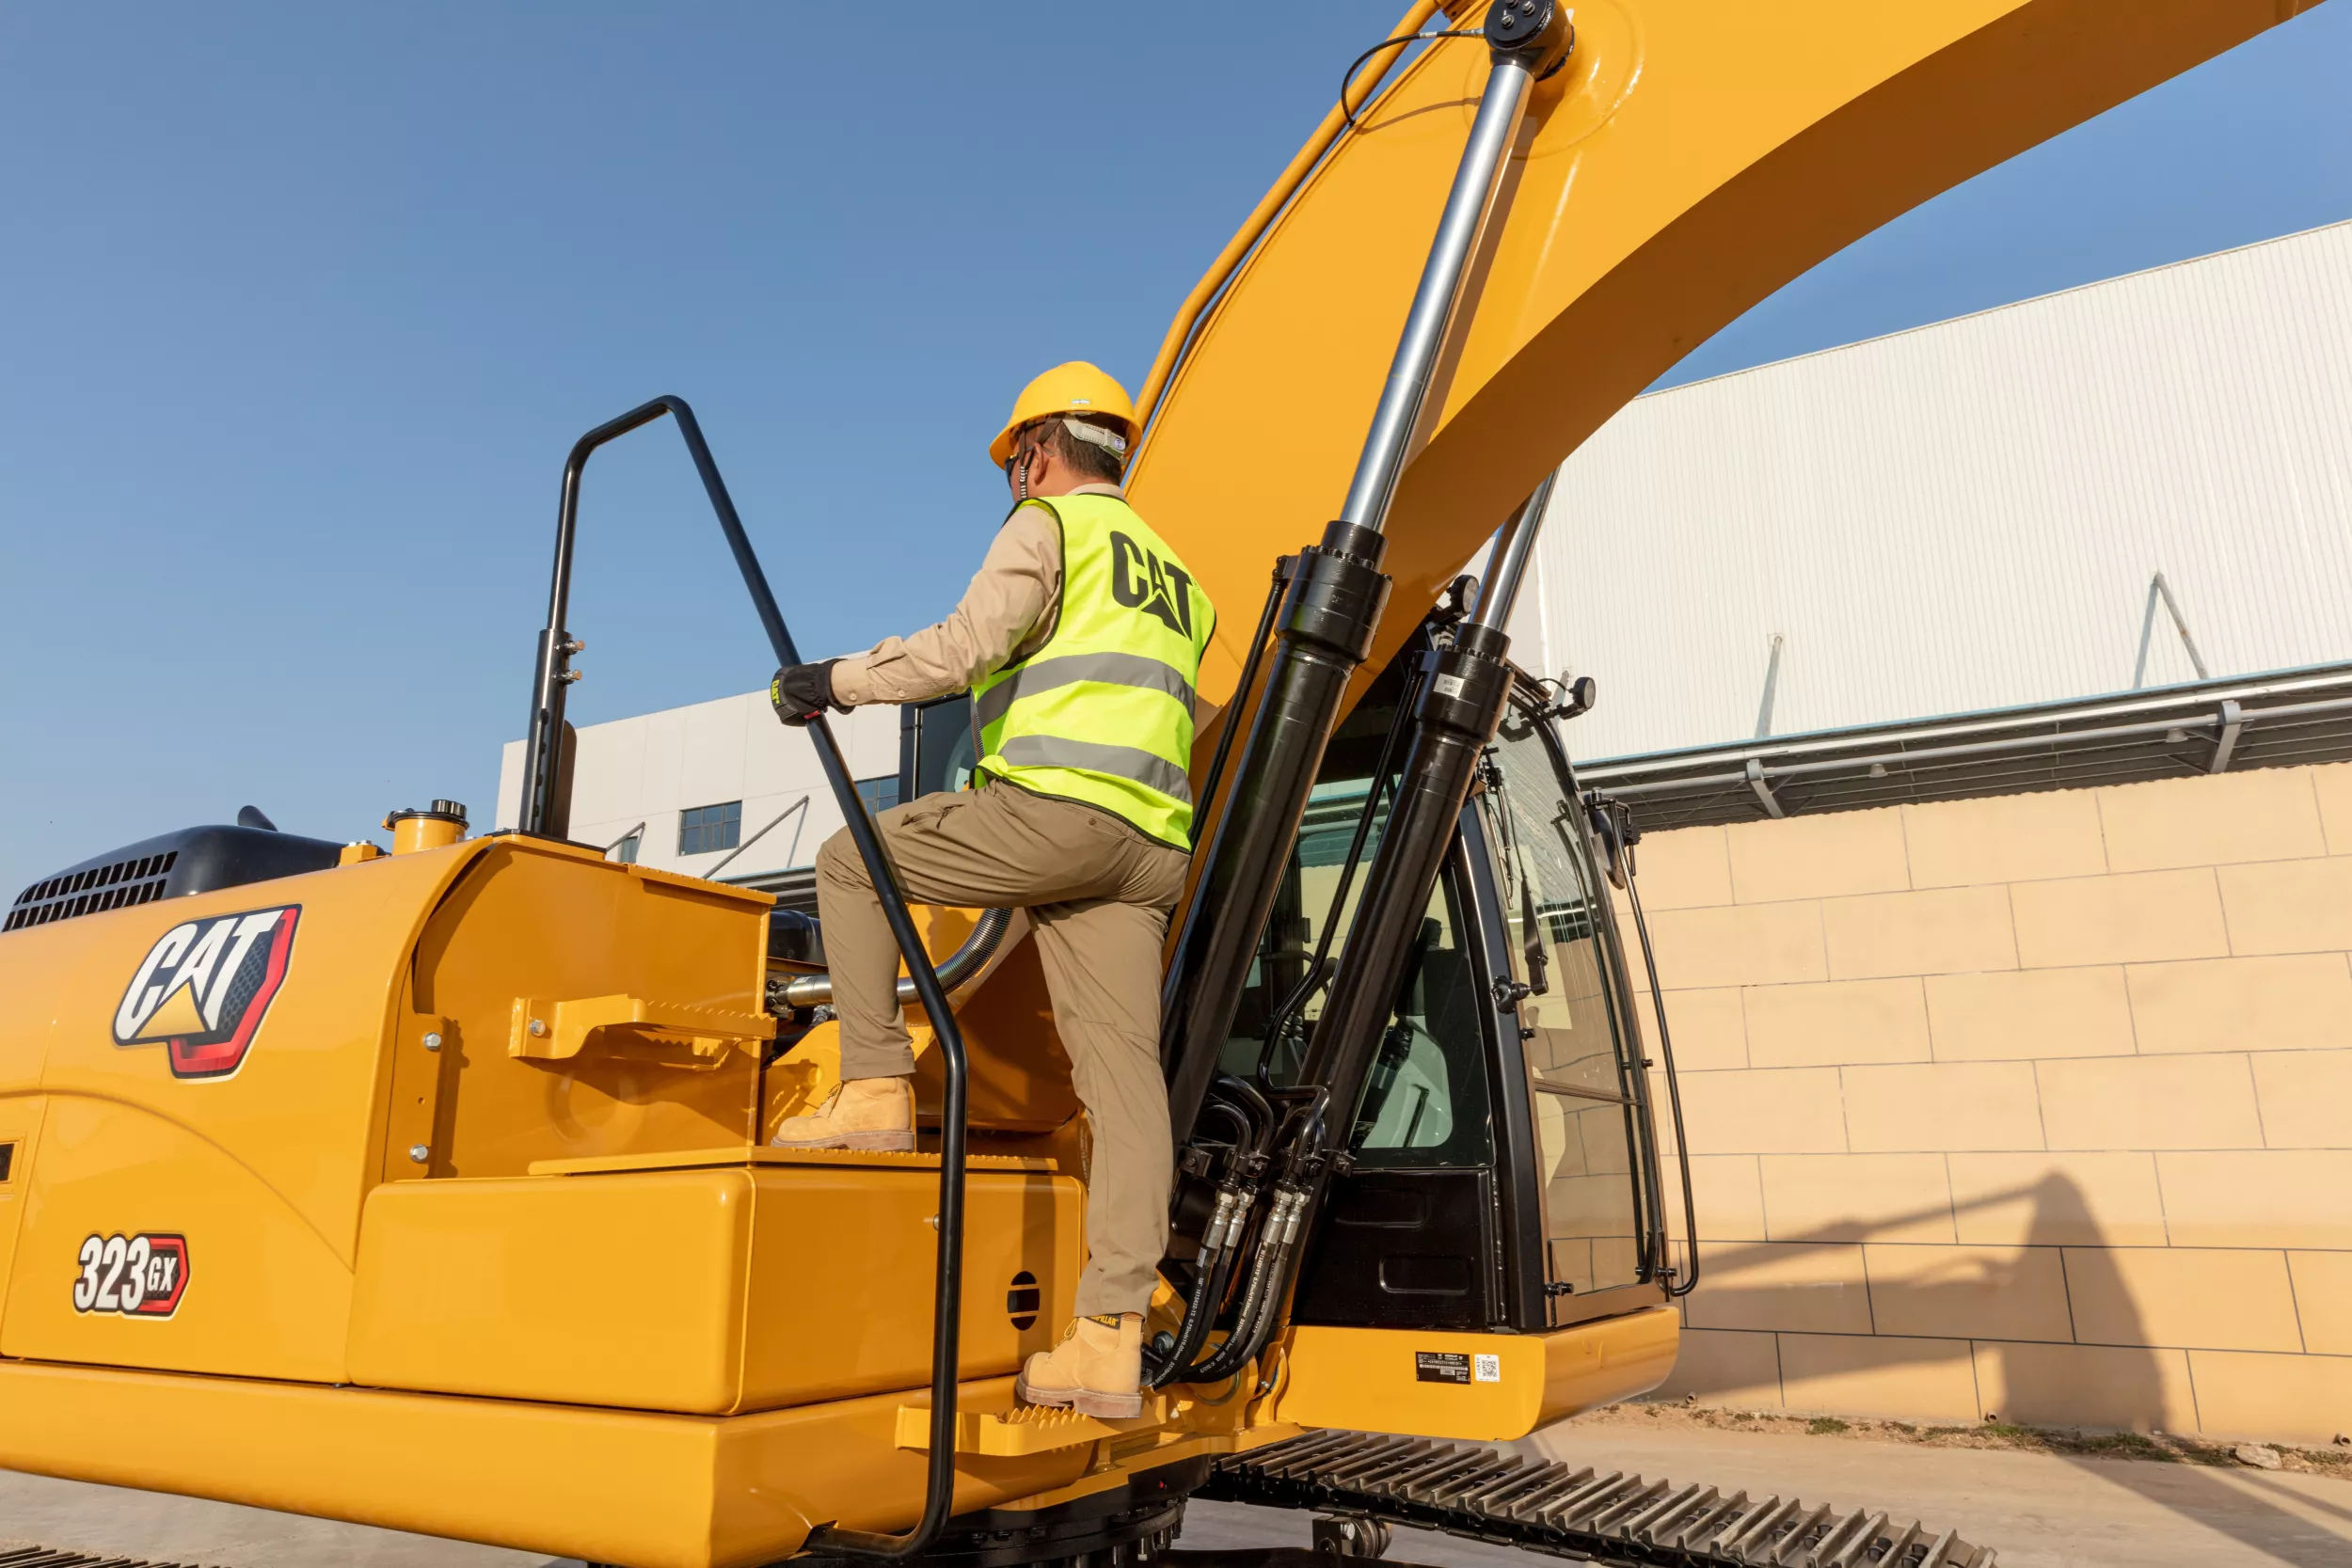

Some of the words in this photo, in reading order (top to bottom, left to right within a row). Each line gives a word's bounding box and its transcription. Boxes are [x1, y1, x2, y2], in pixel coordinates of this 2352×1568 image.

[1110, 531, 1193, 641] CAT
[771, 679, 780, 701] CAT
[116, 910, 284, 1040] CAT
[74, 1237, 151, 1310] 323
[147, 1257, 177, 1291] GX
